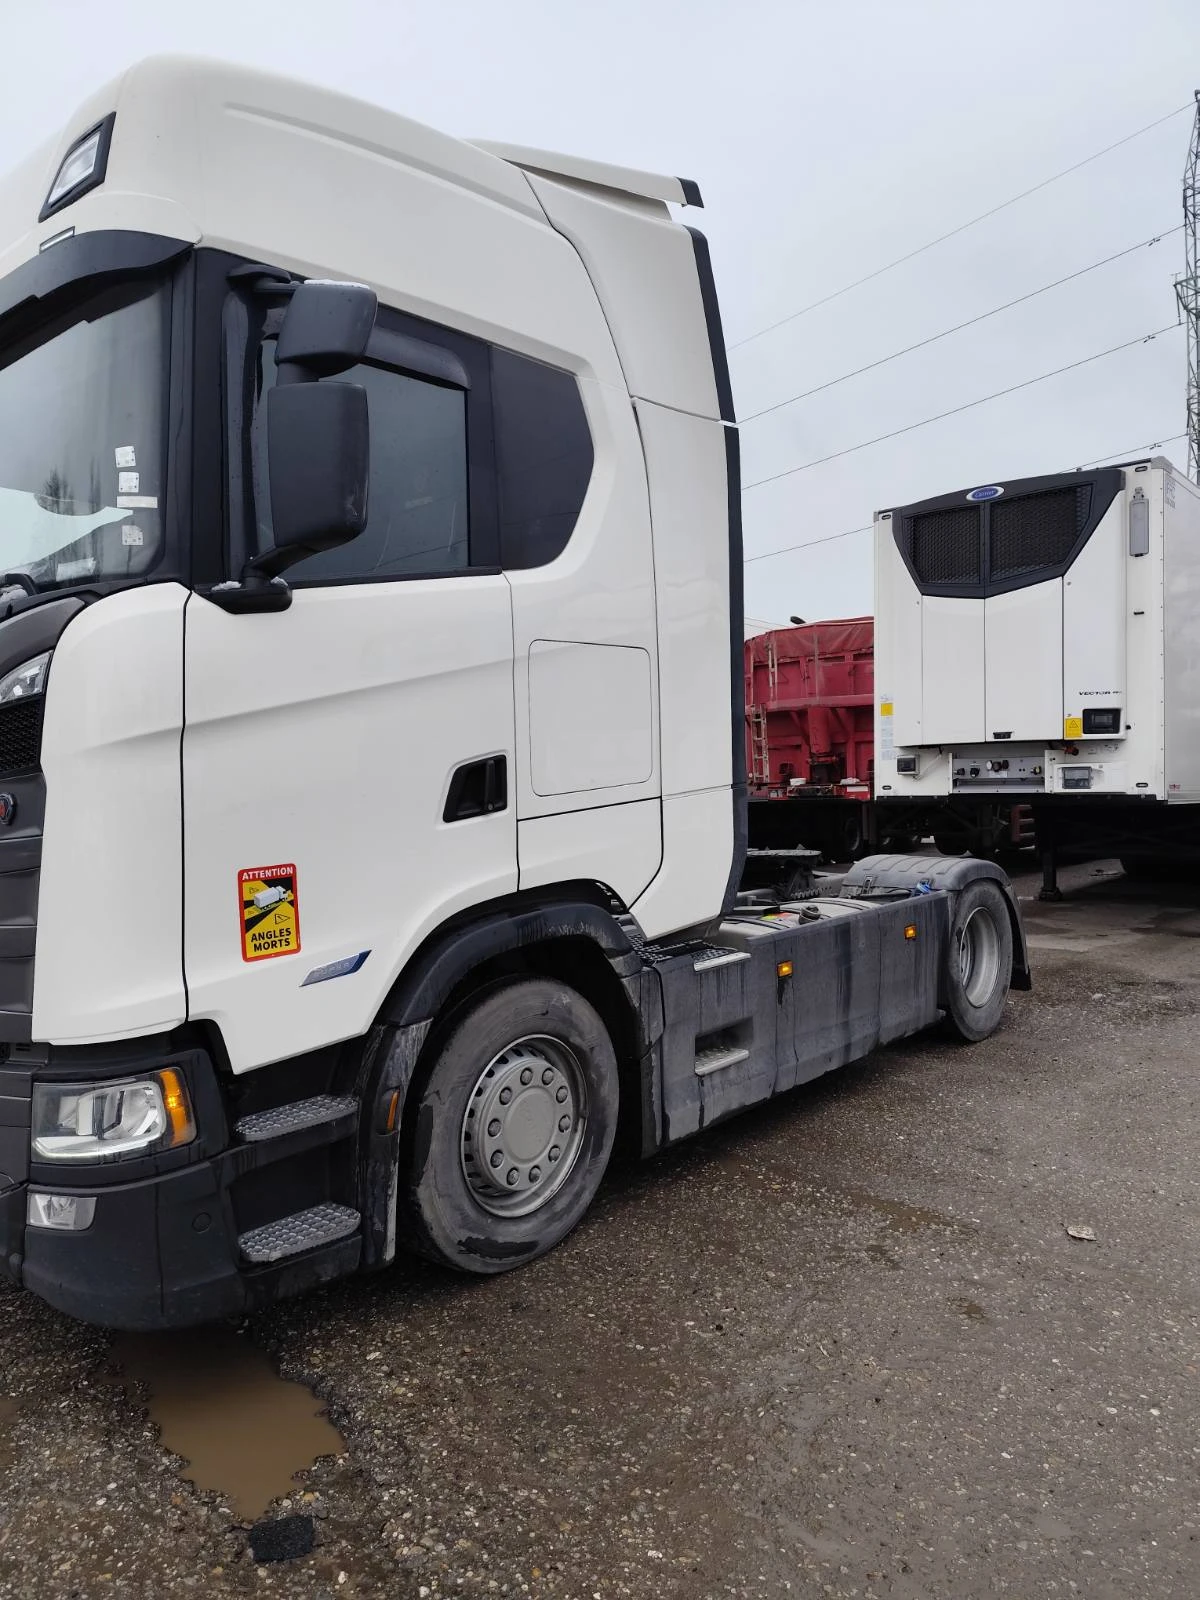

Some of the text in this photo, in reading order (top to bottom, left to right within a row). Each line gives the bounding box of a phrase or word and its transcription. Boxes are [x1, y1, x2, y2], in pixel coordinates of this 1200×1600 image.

[242, 867, 294, 881] ATTENTION
[251, 928, 292, 943] ANGLES
[253, 938, 291, 952] MORTS
